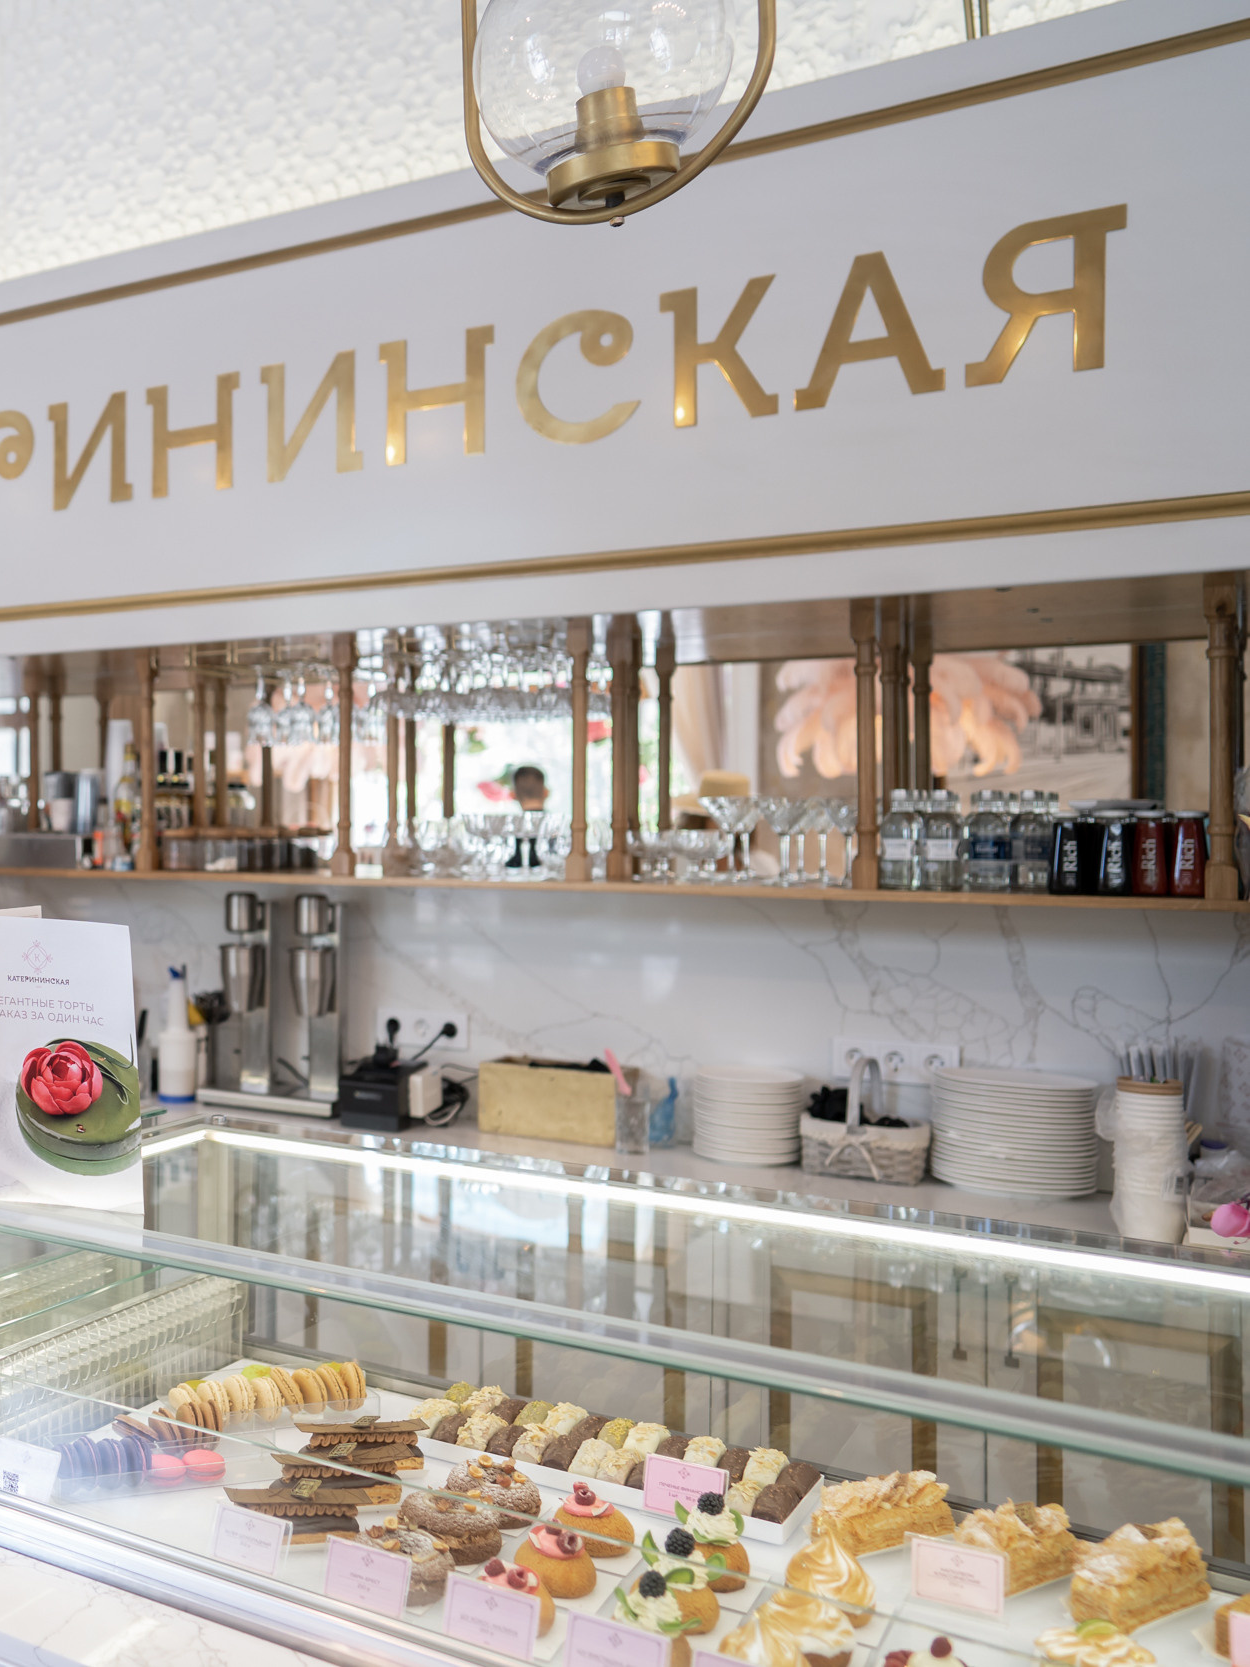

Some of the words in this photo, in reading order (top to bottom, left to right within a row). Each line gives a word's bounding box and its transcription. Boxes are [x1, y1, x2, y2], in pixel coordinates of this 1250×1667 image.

[1063, 840, 1078, 872] Rich
[1107, 841, 1122, 873] Rich
[1141, 838, 1157, 870] Rich
[1180, 838, 1195, 870] Rich
[7, 975, 70, 986] КАТЕРИНИНСКАЯ
[30, 1011, 45, 1021] ЗА
[47, 1012, 80, 1024] ОДИН
[82, 1016, 105, 1027] ЧАС
[58, 1000, 95, 1012] ТОРТЫ
